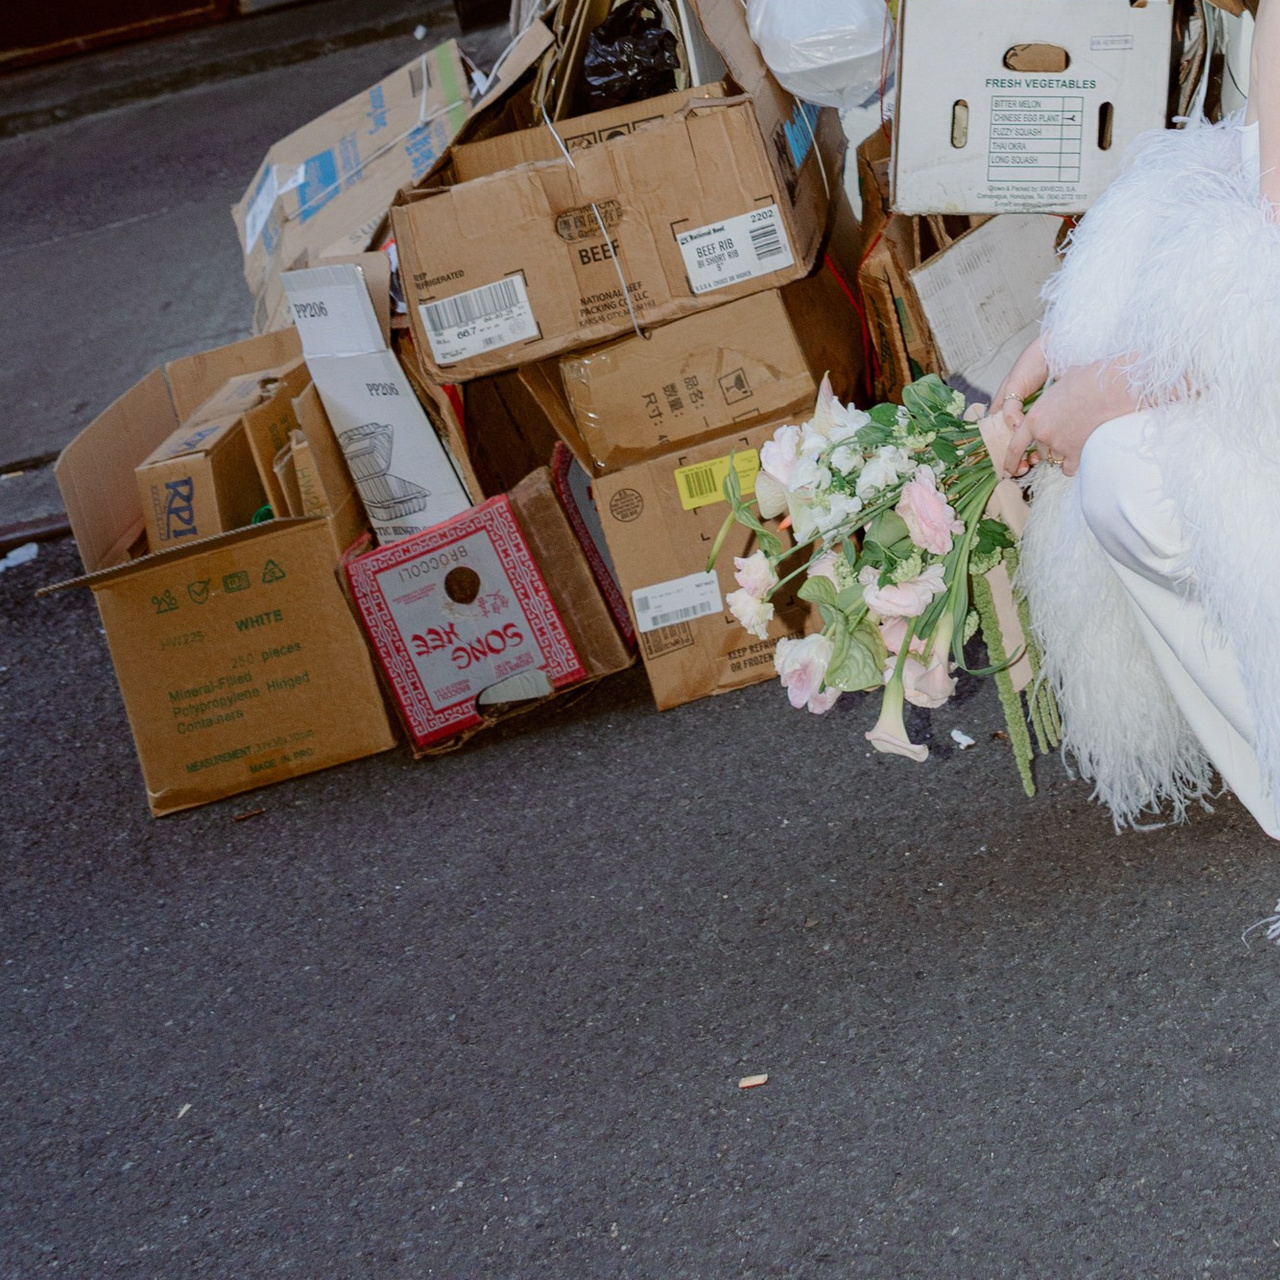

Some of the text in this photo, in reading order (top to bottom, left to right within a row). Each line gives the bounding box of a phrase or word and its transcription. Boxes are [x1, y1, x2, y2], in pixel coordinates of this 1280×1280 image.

[985, 78, 1097, 89] FRESH VEGETABLES
[993, 100, 1042, 108] BITTER MELON
[993, 114, 1060, 123] CHINESE EGG PLANT
[992, 128, 1043, 137] FUZZY SQUASH
[992, 142, 1027, 150] THAI OKRA
[991, 156, 1038, 164] LONG SQUASH
[750, 209, 774, 223] 2202
[578, 239, 621, 266] BEEF
[695, 238, 735, 259] BEEF RIB
[706, 253, 727, 266] SHORT
[727, 249, 740, 260] RIB
[579, 289, 624, 306] NATIONAL
[579, 300, 618, 317] PACKING
[633, 290, 649, 303] LLC
[293, 301, 329, 319] PP206
[365, 382, 400, 397] PP206
[164, 476, 198, 540] RPI
[399, 544, 469, 583] BROCCOLI
[235, 609, 284, 633] WHITE
[410, 621, 461, 657] HEE
[449, 622, 525, 671] SONG
[261, 641, 302, 662] pieces
[727, 646, 748, 661] KEEP
[730, 652, 775, 673] OR FROZEN
[168, 671, 253, 703] Mineral-Filled
[172, 671, 311, 720] Polypropylene Hinged
[176, 710, 245, 735] Containers
[249, 747, 315, 774] MADE IN PRC
